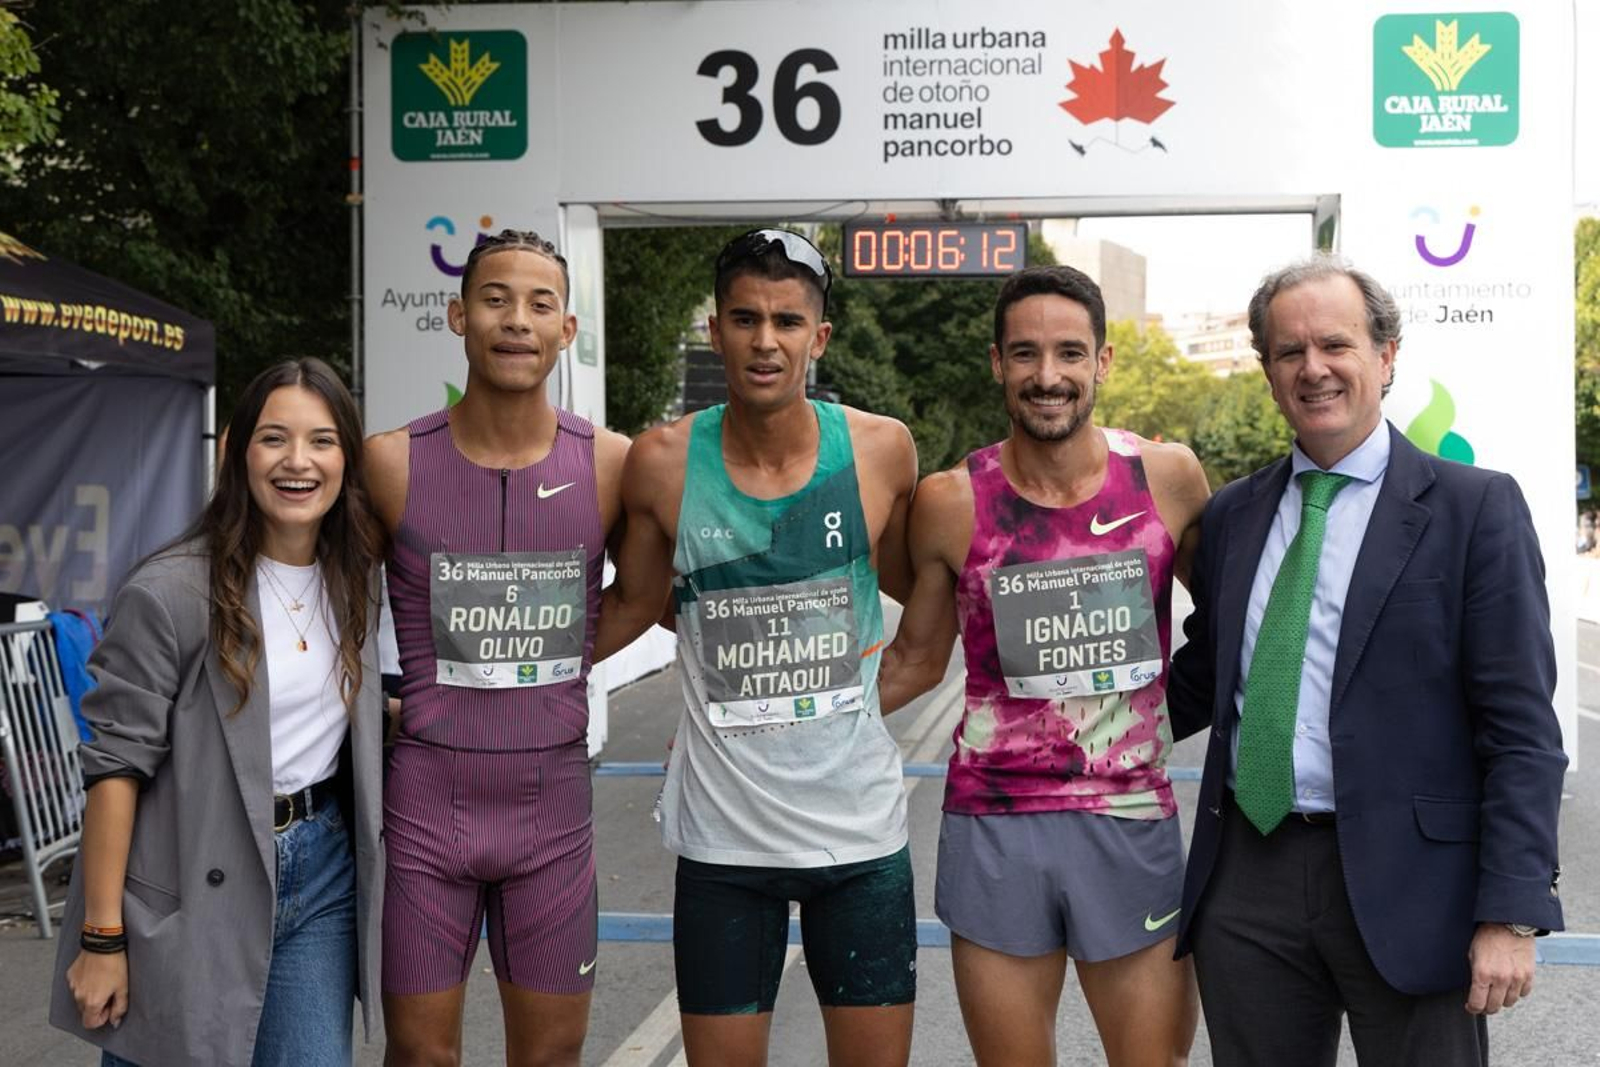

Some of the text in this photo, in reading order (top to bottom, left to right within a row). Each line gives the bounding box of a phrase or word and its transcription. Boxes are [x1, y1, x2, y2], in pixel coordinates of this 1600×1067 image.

[883, 27, 1046, 50] milla urbana
[883, 53, 1043, 77] internacional
[695, 47, 842, 148] 36
[882, 79, 990, 103] de otoño
[1384, 94, 1509, 114] CAJA RURAL
[403, 110, 518, 129] CAJA RURAL
[883, 107, 982, 130] manuel
[883, 134, 1013, 163] pancorbo
[853, 230, 1016, 270] 00:06:12
[1387, 281, 1532, 299] untamiento
[415, 310, 444, 331] de
[1434, 303, 1494, 324] Jaén
[701, 527, 735, 540] OAC
[438, 562, 581, 581] 36 Manuel Pancorbo
[998, 566, 1144, 596] 36 Manuel Pancorbo
[506, 585, 519, 603] 6
[1069, 591, 1081, 610] 1
[449, 604, 573, 633] RONALDO
[706, 594, 849, 620] 36 Manuel Pancorbo
[767, 617, 792, 637] 11
[1025, 606, 1131, 644] IGNACIO
[479, 636, 544, 660] OLIVO
[717, 631, 848, 670] MOHAMED
[1038, 639, 1127, 672] FONTES
[739, 666, 830, 697] ATTAOUI
